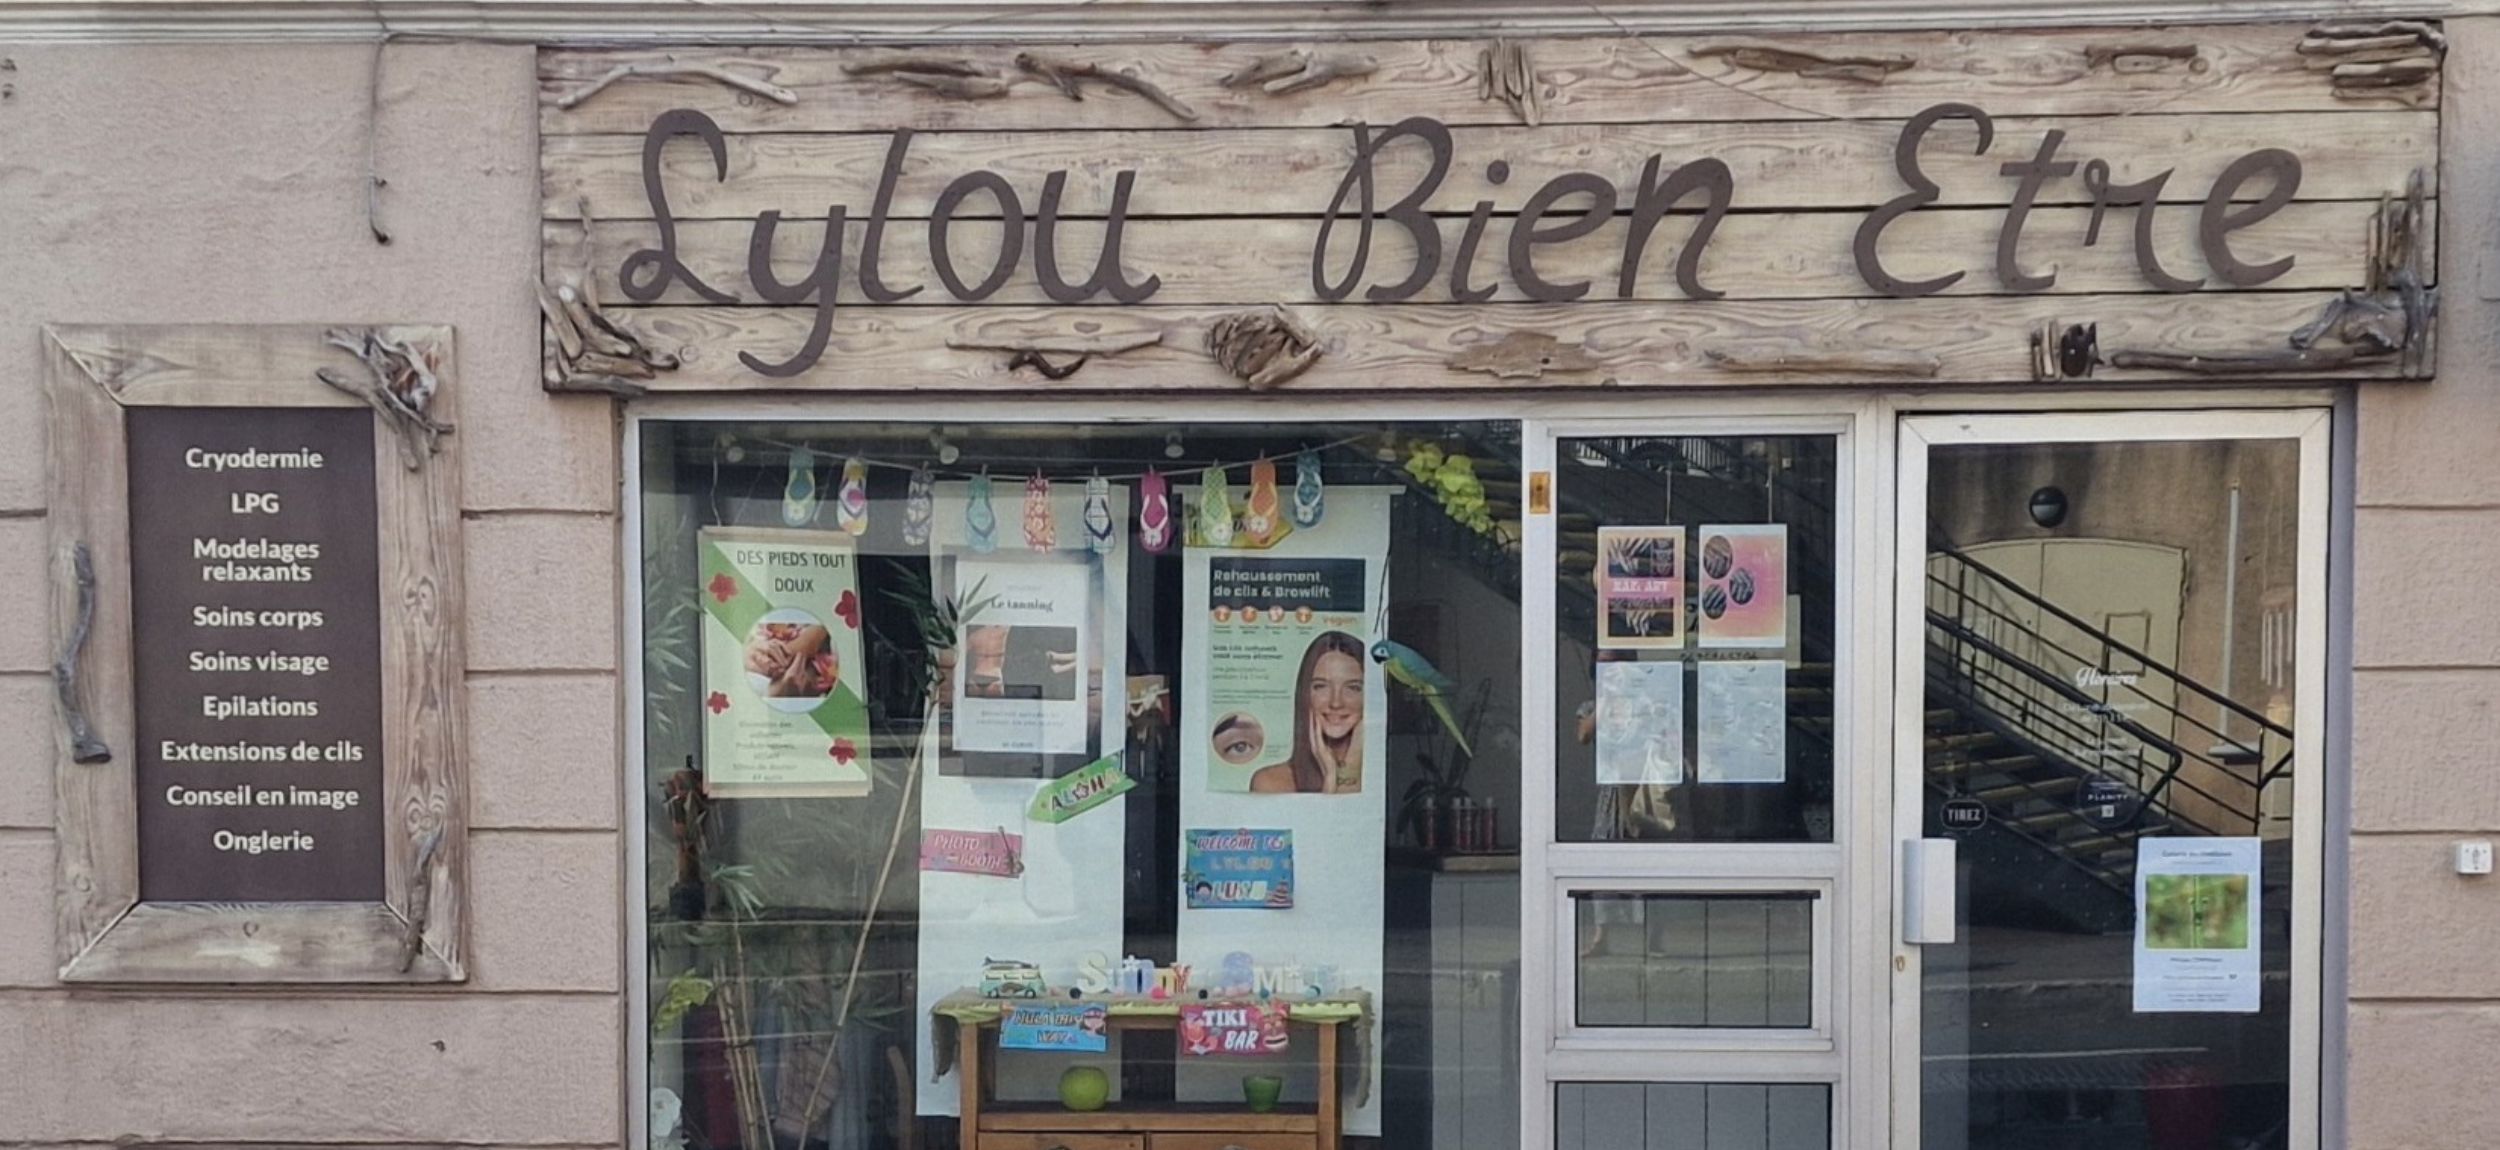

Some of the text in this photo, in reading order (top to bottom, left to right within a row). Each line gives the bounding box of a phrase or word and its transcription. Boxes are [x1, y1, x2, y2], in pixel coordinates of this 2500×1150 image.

[619, 102, 2302, 378] Lylou Bien Etre
[186, 447, 323, 472] Cryodermie
[231, 492, 280, 514] LPG
[193, 537, 320, 566] Modelages
[736, 550, 846, 569] DES PIEDS TOUT
[203, 560, 312, 582] relaxants
[1212, 568, 1321, 583] Rehaussement
[774, 578, 815, 593] DOUX
[1212, 585, 1331, 599] de cils & Browlift
[193, 606, 324, 631] Soins corps
[189, 650, 329, 676] Soins visage
[203, 695, 319, 721] Epilations
[161, 740, 363, 762] Extensions de cils
[166, 785, 359, 811] Conseil en image
[1947, 808, 1981, 822] TIREZ
[213, 829, 315, 855] Onglerie
[1202, 1009, 1248, 1027] TIKI
[1224, 1030, 1259, 1051] BAR
